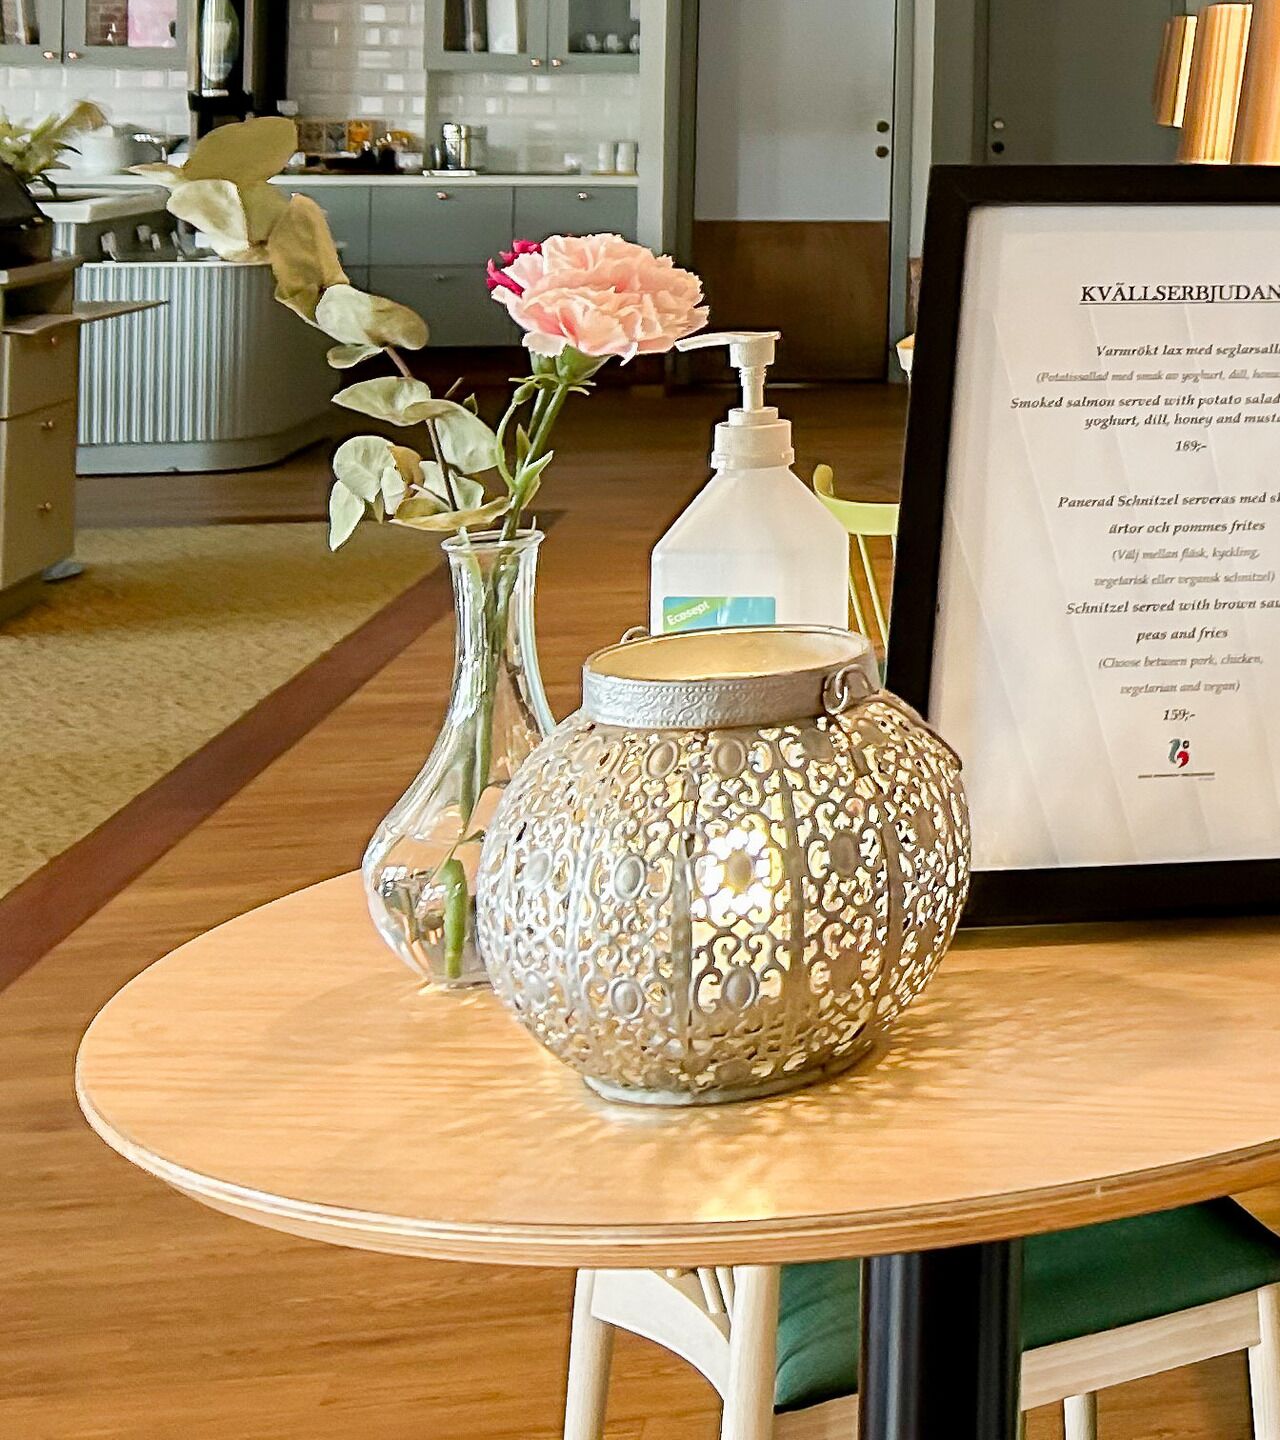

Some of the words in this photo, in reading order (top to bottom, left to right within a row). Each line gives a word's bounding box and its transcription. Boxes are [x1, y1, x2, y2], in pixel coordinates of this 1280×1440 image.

[1096, 344, 1159, 357] Varmrökt
[1162, 344, 1184, 356] lax
[1185, 343, 1214, 356] med
[1010, 396, 1064, 409] Smoked
[1066, 396, 1116, 408] salmon
[1118, 394, 1162, 407] served
[1164, 393, 1196, 406] with
[1196, 394, 1242, 410] potato
[1084, 414, 1140, 430] yoghurt,
[1173, 412, 1214, 428] honey
[1215, 412, 1242, 424] and
[1057, 494, 1116, 509] Panerad
[1117, 493, 1180, 508] Schnitzel
[1182, 495, 1236, 506] serveras
[1239, 491, 1267, 504] med
[1108, 523, 1145, 535] ärtor
[1146, 521, 1170, 534] och
[1172, 523, 1228, 537] pommes
[1228, 519, 1266, 535] frites
[666, 600, 711, 626] Ecosept
[1065, 600, 1130, 615] Schnitzel
[1132, 599, 1176, 613] served
[1178, 598, 1211, 612] with
[1213, 598, 1257, 611] brown
[1135, 631, 1168, 645] peas
[1170, 626, 1197, 640] and
[1196, 626, 1228, 643] fries
[1179, 680, 1202, 692] and
[1162, 708, 1196, 723] 159;-
